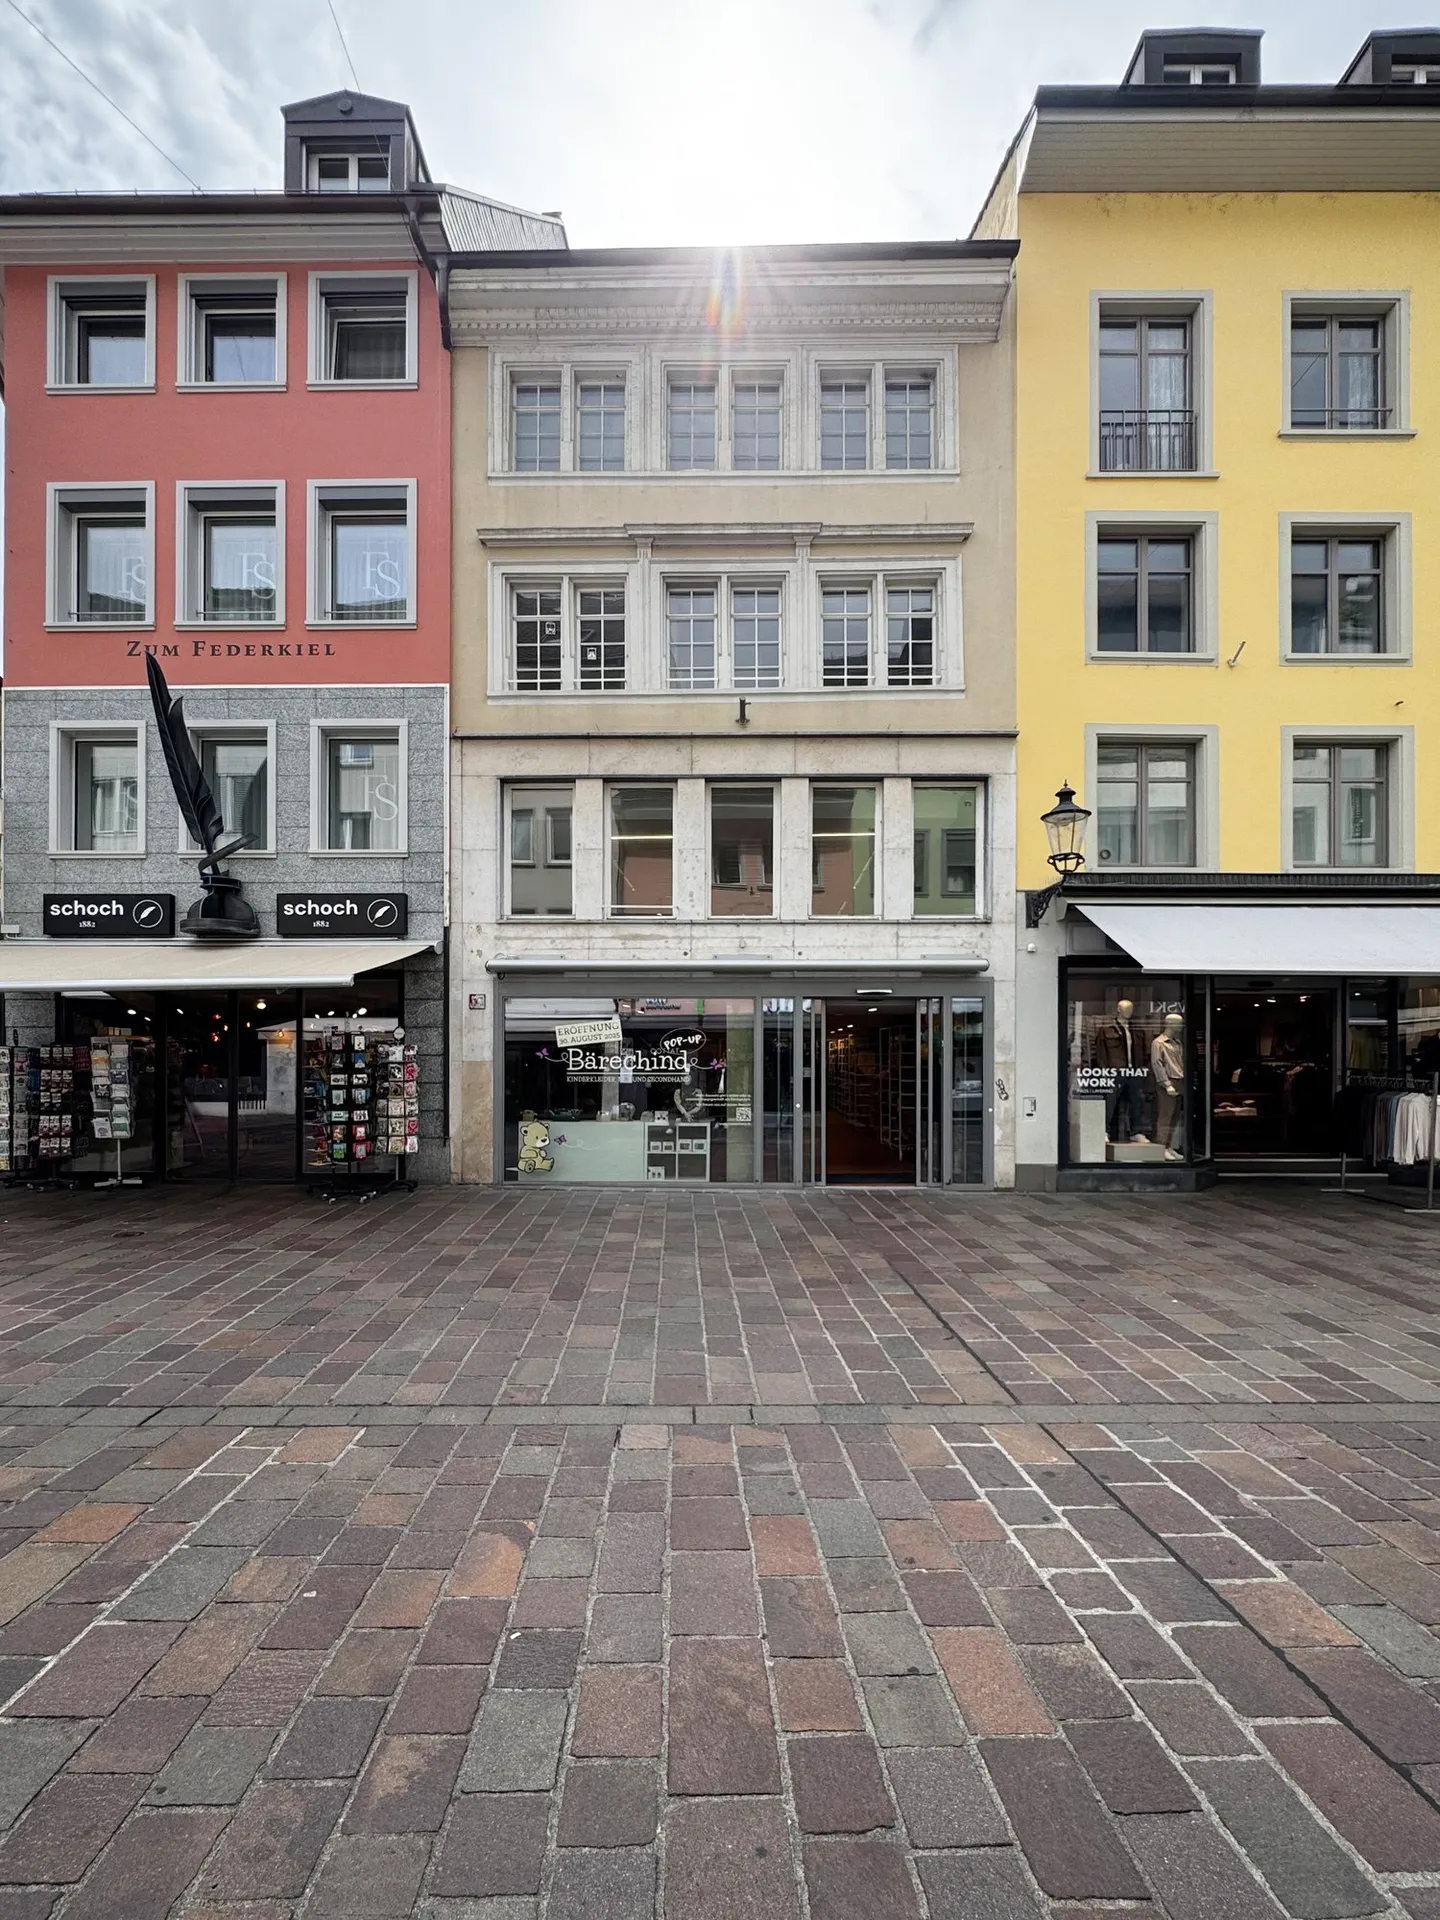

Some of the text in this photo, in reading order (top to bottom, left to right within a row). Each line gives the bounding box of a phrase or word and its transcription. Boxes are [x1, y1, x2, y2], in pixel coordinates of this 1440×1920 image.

[362, 551, 400, 598] FS
[192, 640, 336, 657] FEDERKIEL
[361, 774, 398, 821] FS
[50, 900, 124, 916] schoch
[283, 899, 358, 915] schoch
[312, 920, 330, 928] 1882
[557, 1021, 619, 1036] ERÖFFNUNG
[570, 1033, 603, 1044] AUGUST
[603, 1032, 621, 1040] 2025
[663, 1034, 703, 1050] POP-UP
[566, 1048, 690, 1071] Bärechind
[632, 1075, 646, 1083] UND
[1076, 1067, 1149, 1077] LOOKS THAT
[1077, 1077, 1116, 1088] WORK
